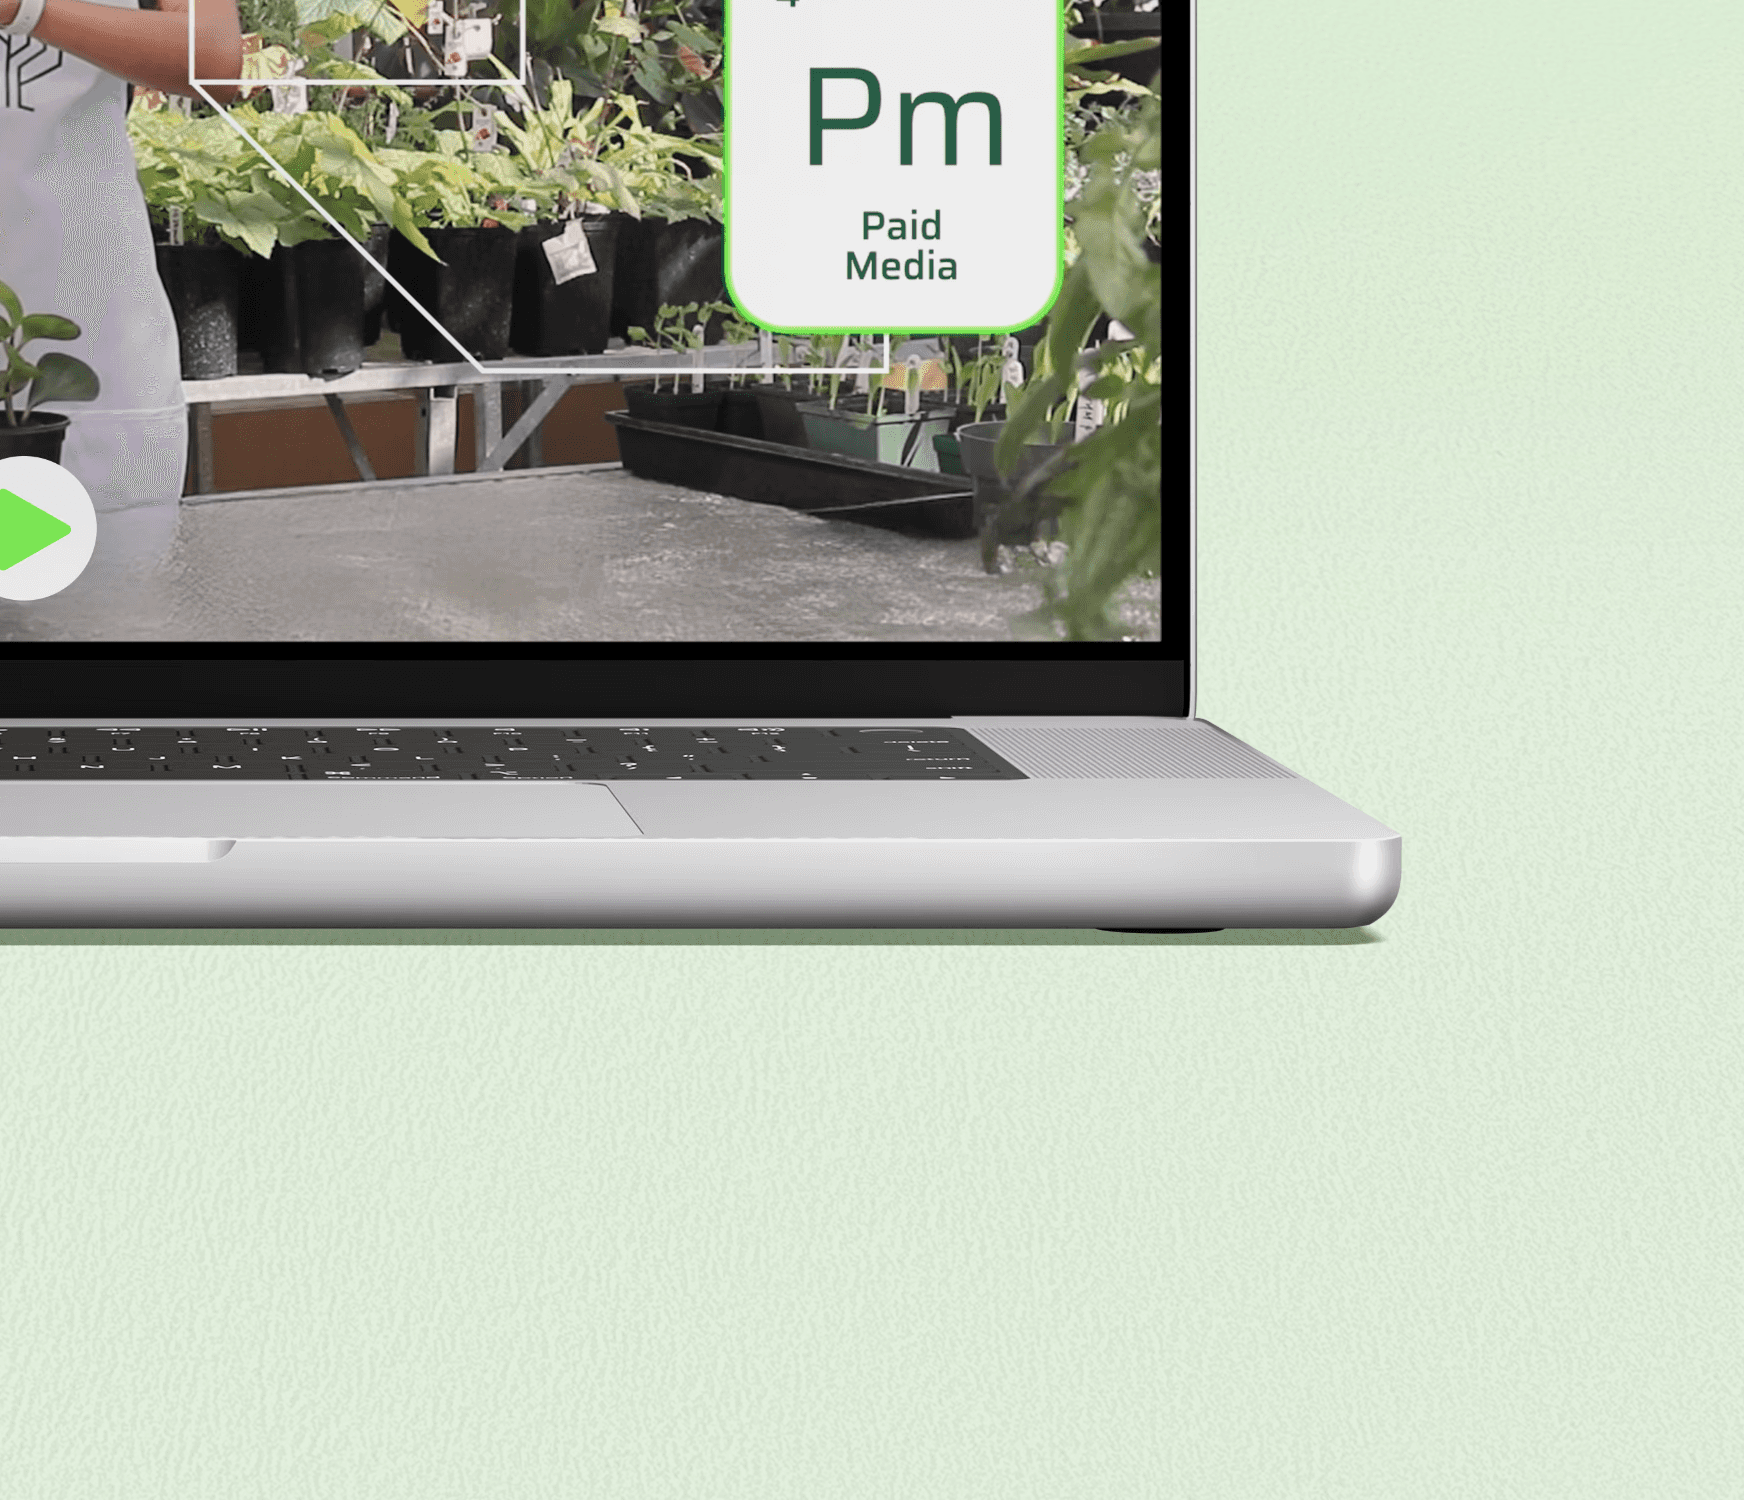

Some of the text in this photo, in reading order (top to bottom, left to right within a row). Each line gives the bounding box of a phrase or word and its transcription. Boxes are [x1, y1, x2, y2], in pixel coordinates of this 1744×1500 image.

[809, 67, 1002, 166] Pm
[863, 209, 941, 241] Paid
[846, 249, 957, 281] Media
